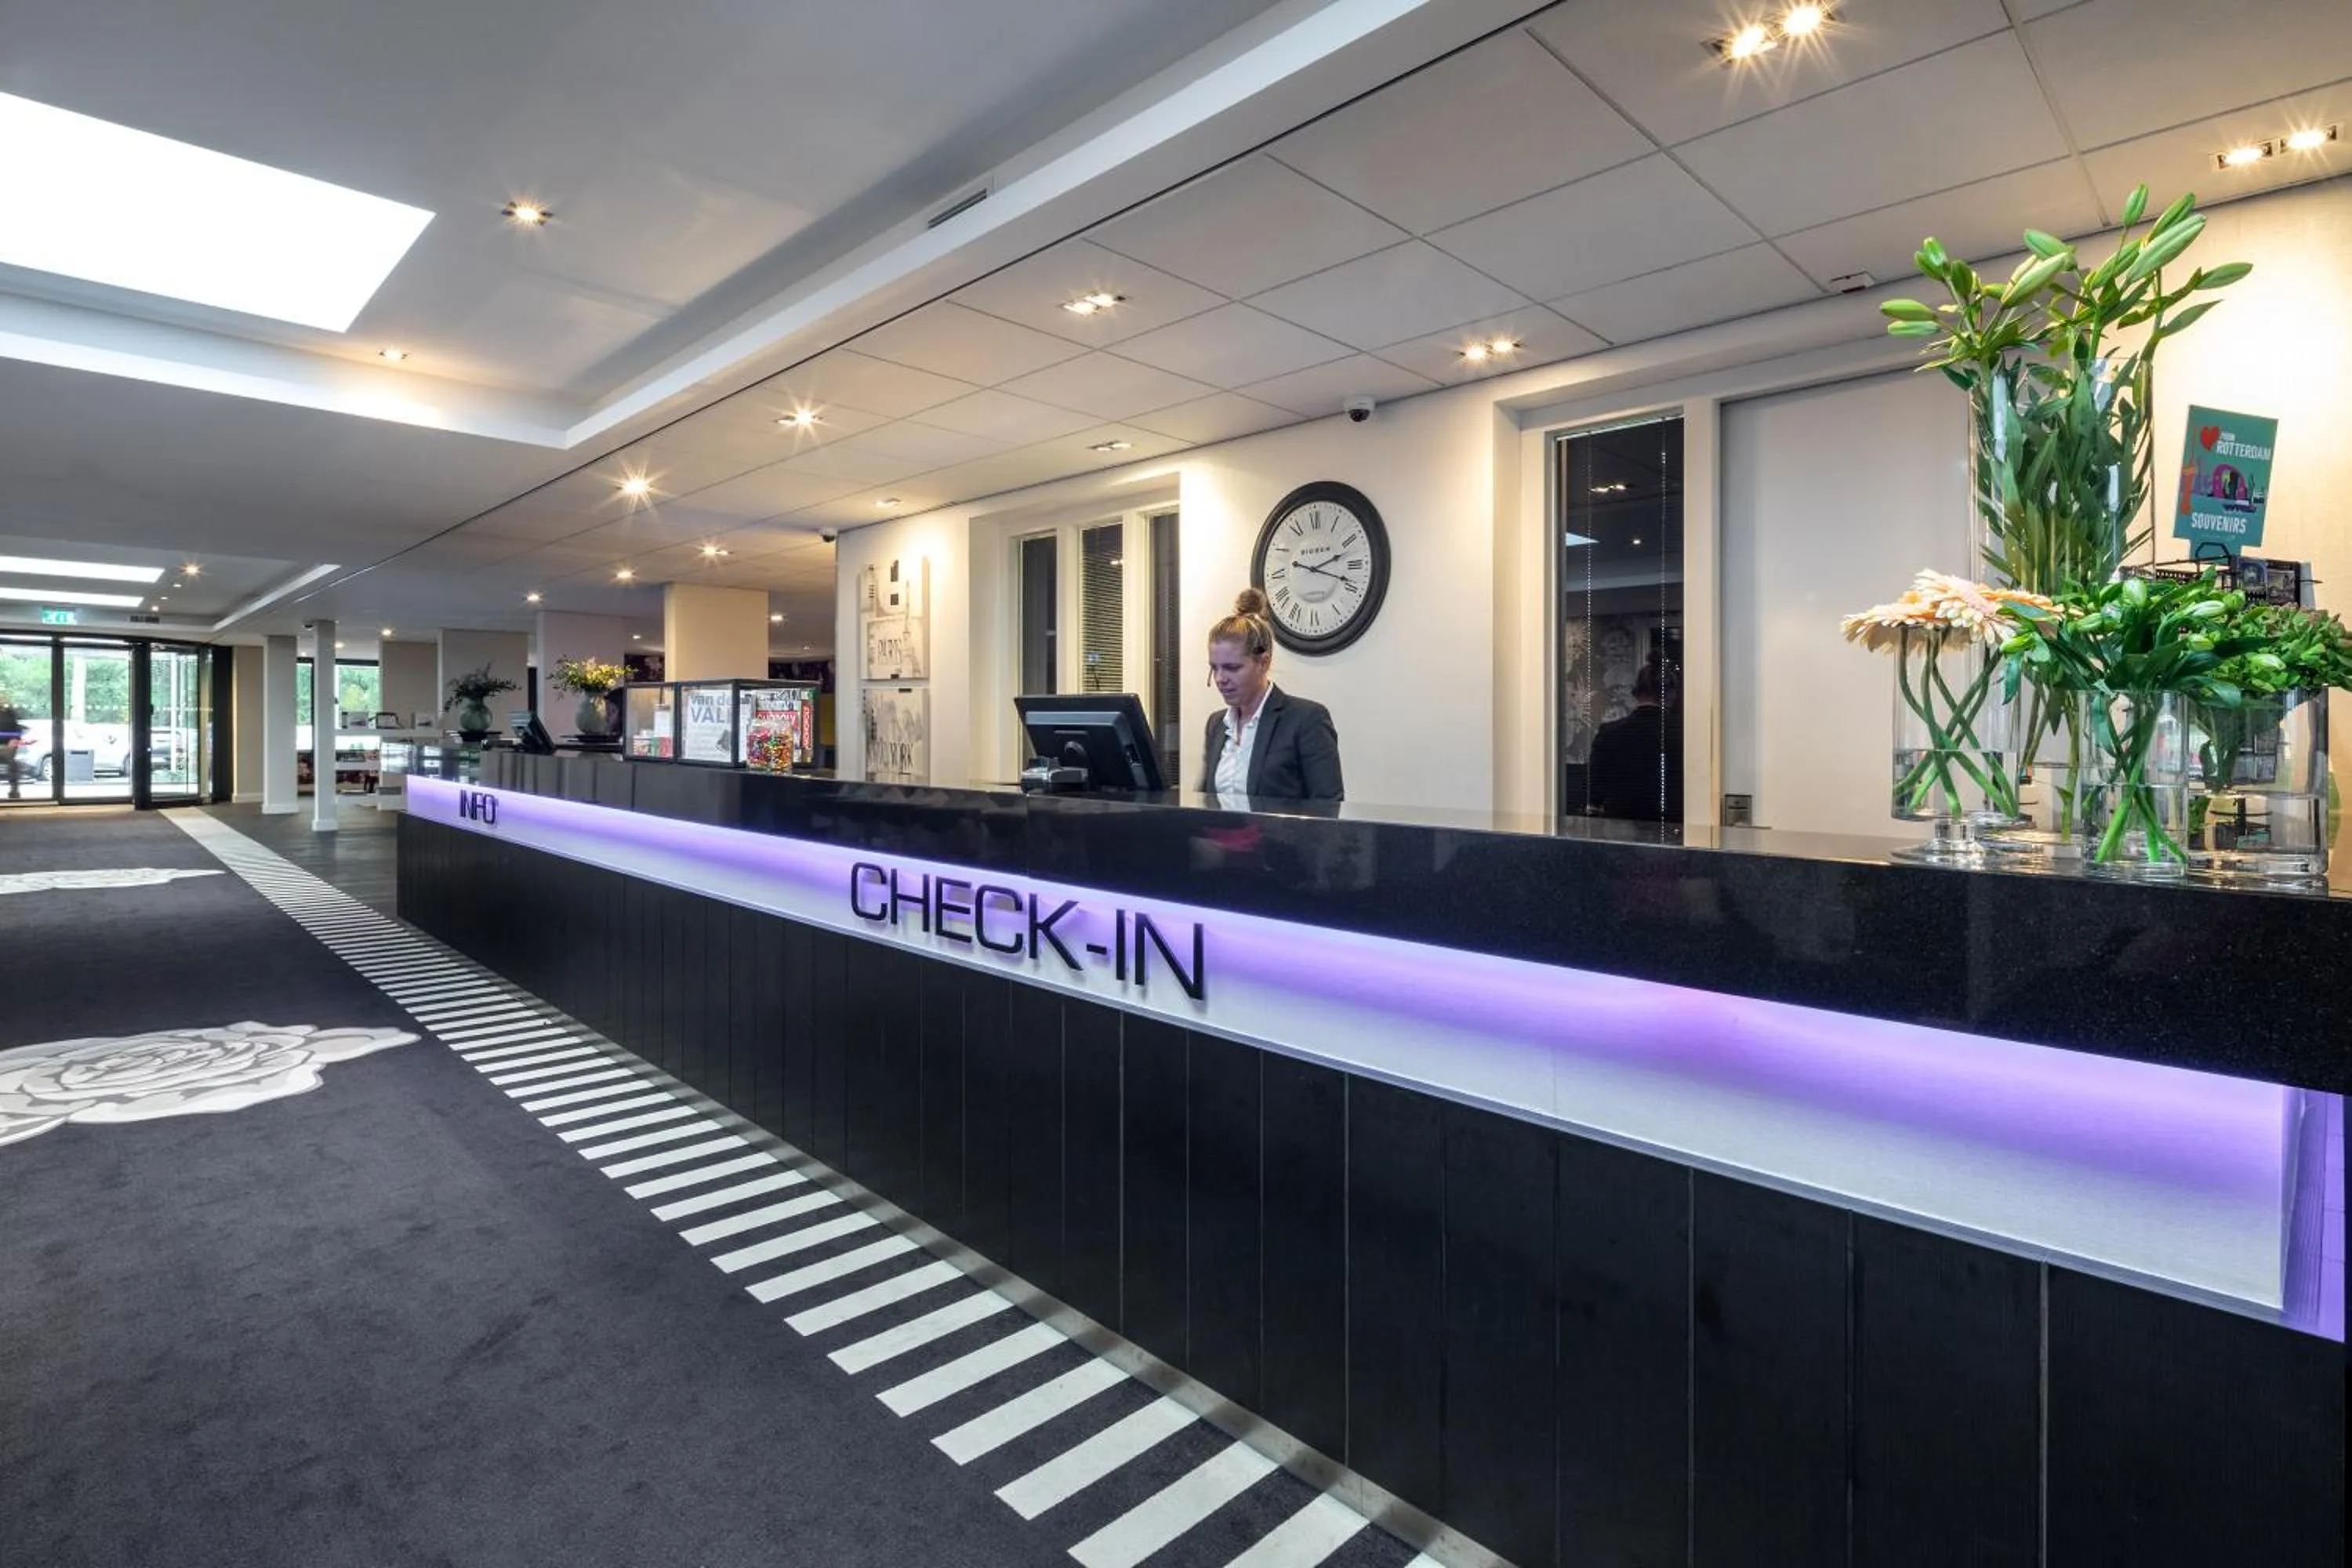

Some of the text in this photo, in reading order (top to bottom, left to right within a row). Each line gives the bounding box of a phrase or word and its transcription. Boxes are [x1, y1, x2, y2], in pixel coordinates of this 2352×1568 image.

[2216, 440, 2271, 460] ROTTERDAM
[2191, 512, 2247, 534] SOUVENIRS
[691, 706, 732, 724] VAL
[460, 789, 496, 824] INFO
[851, 862, 1205, 1001] CHECK-IN
